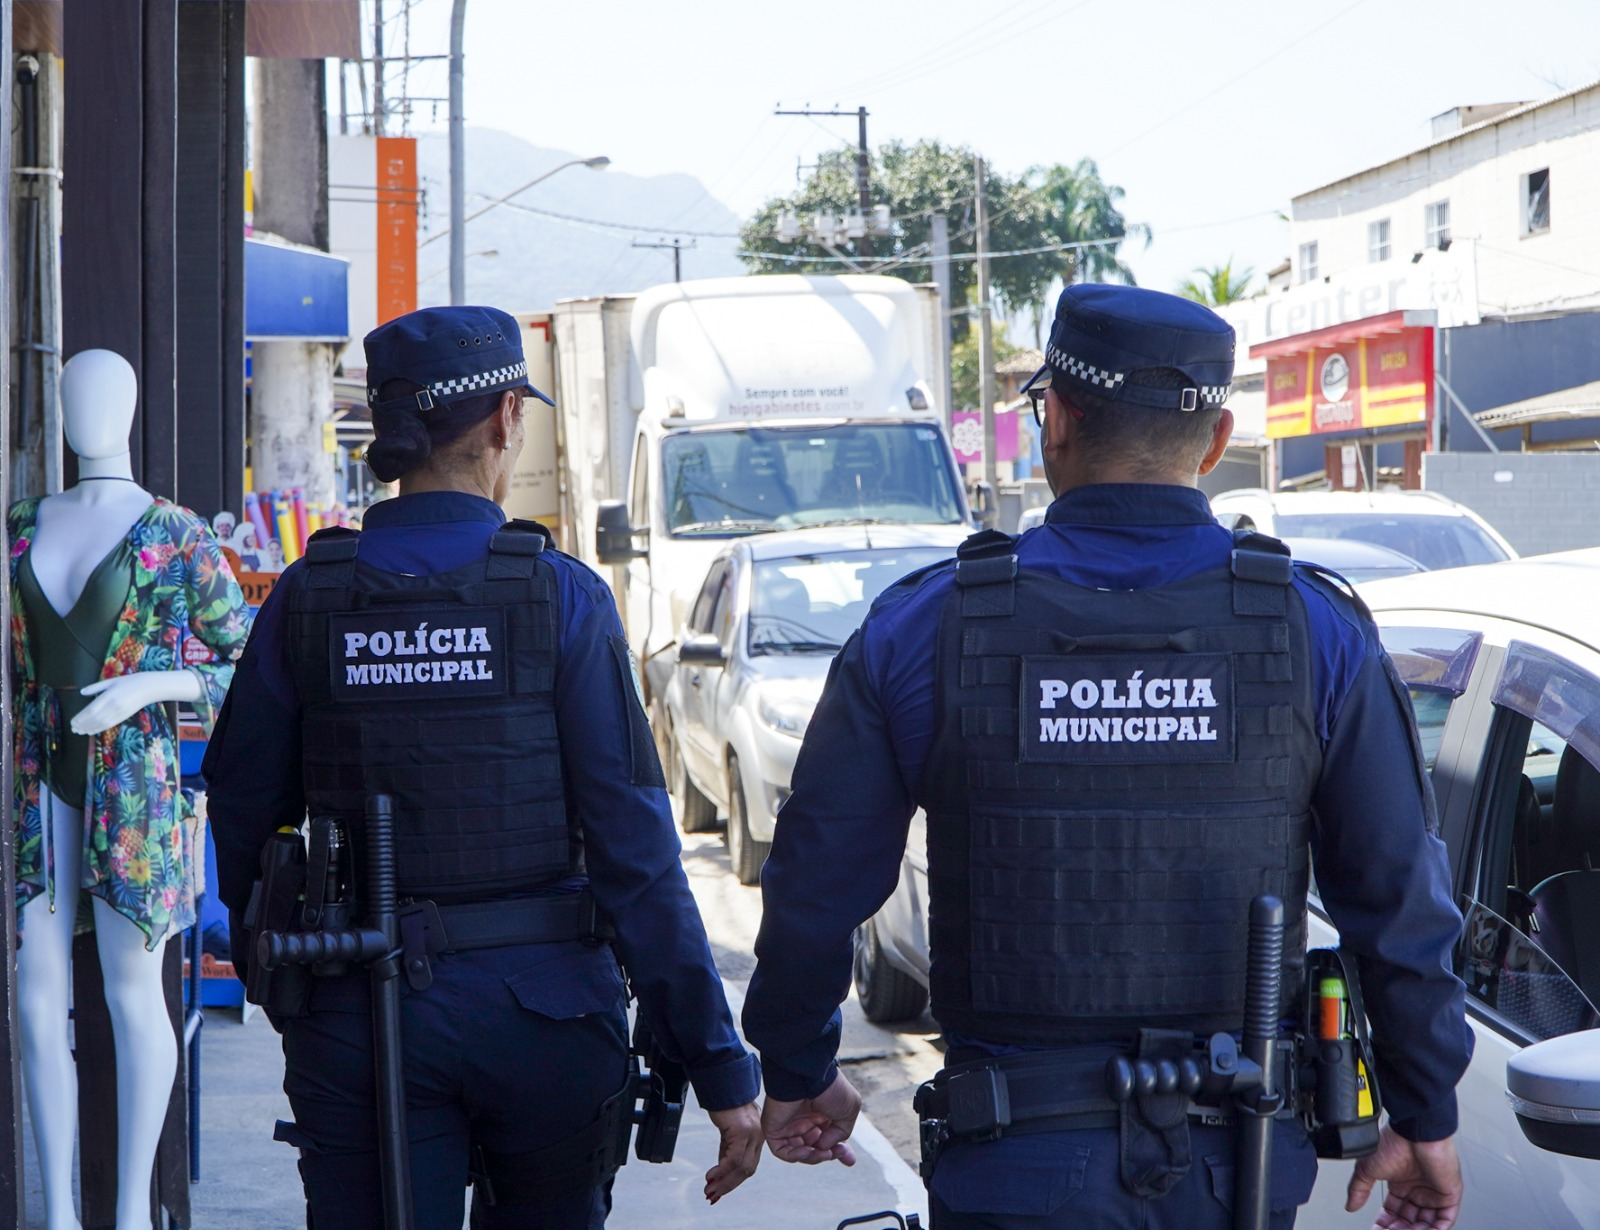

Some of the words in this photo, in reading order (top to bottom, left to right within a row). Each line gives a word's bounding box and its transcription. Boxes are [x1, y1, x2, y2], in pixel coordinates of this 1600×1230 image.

[1265, 276, 1406, 338] Center
[745, 388, 788, 399] Sempre
[792, 388, 816, 398] com
[344, 622, 492, 658] POLÍCIA
[346, 659, 493, 685] MUNICIPAL
[1039, 670, 1218, 709] POLÍCIA
[1039, 716, 1218, 742] MUNICIPAL
